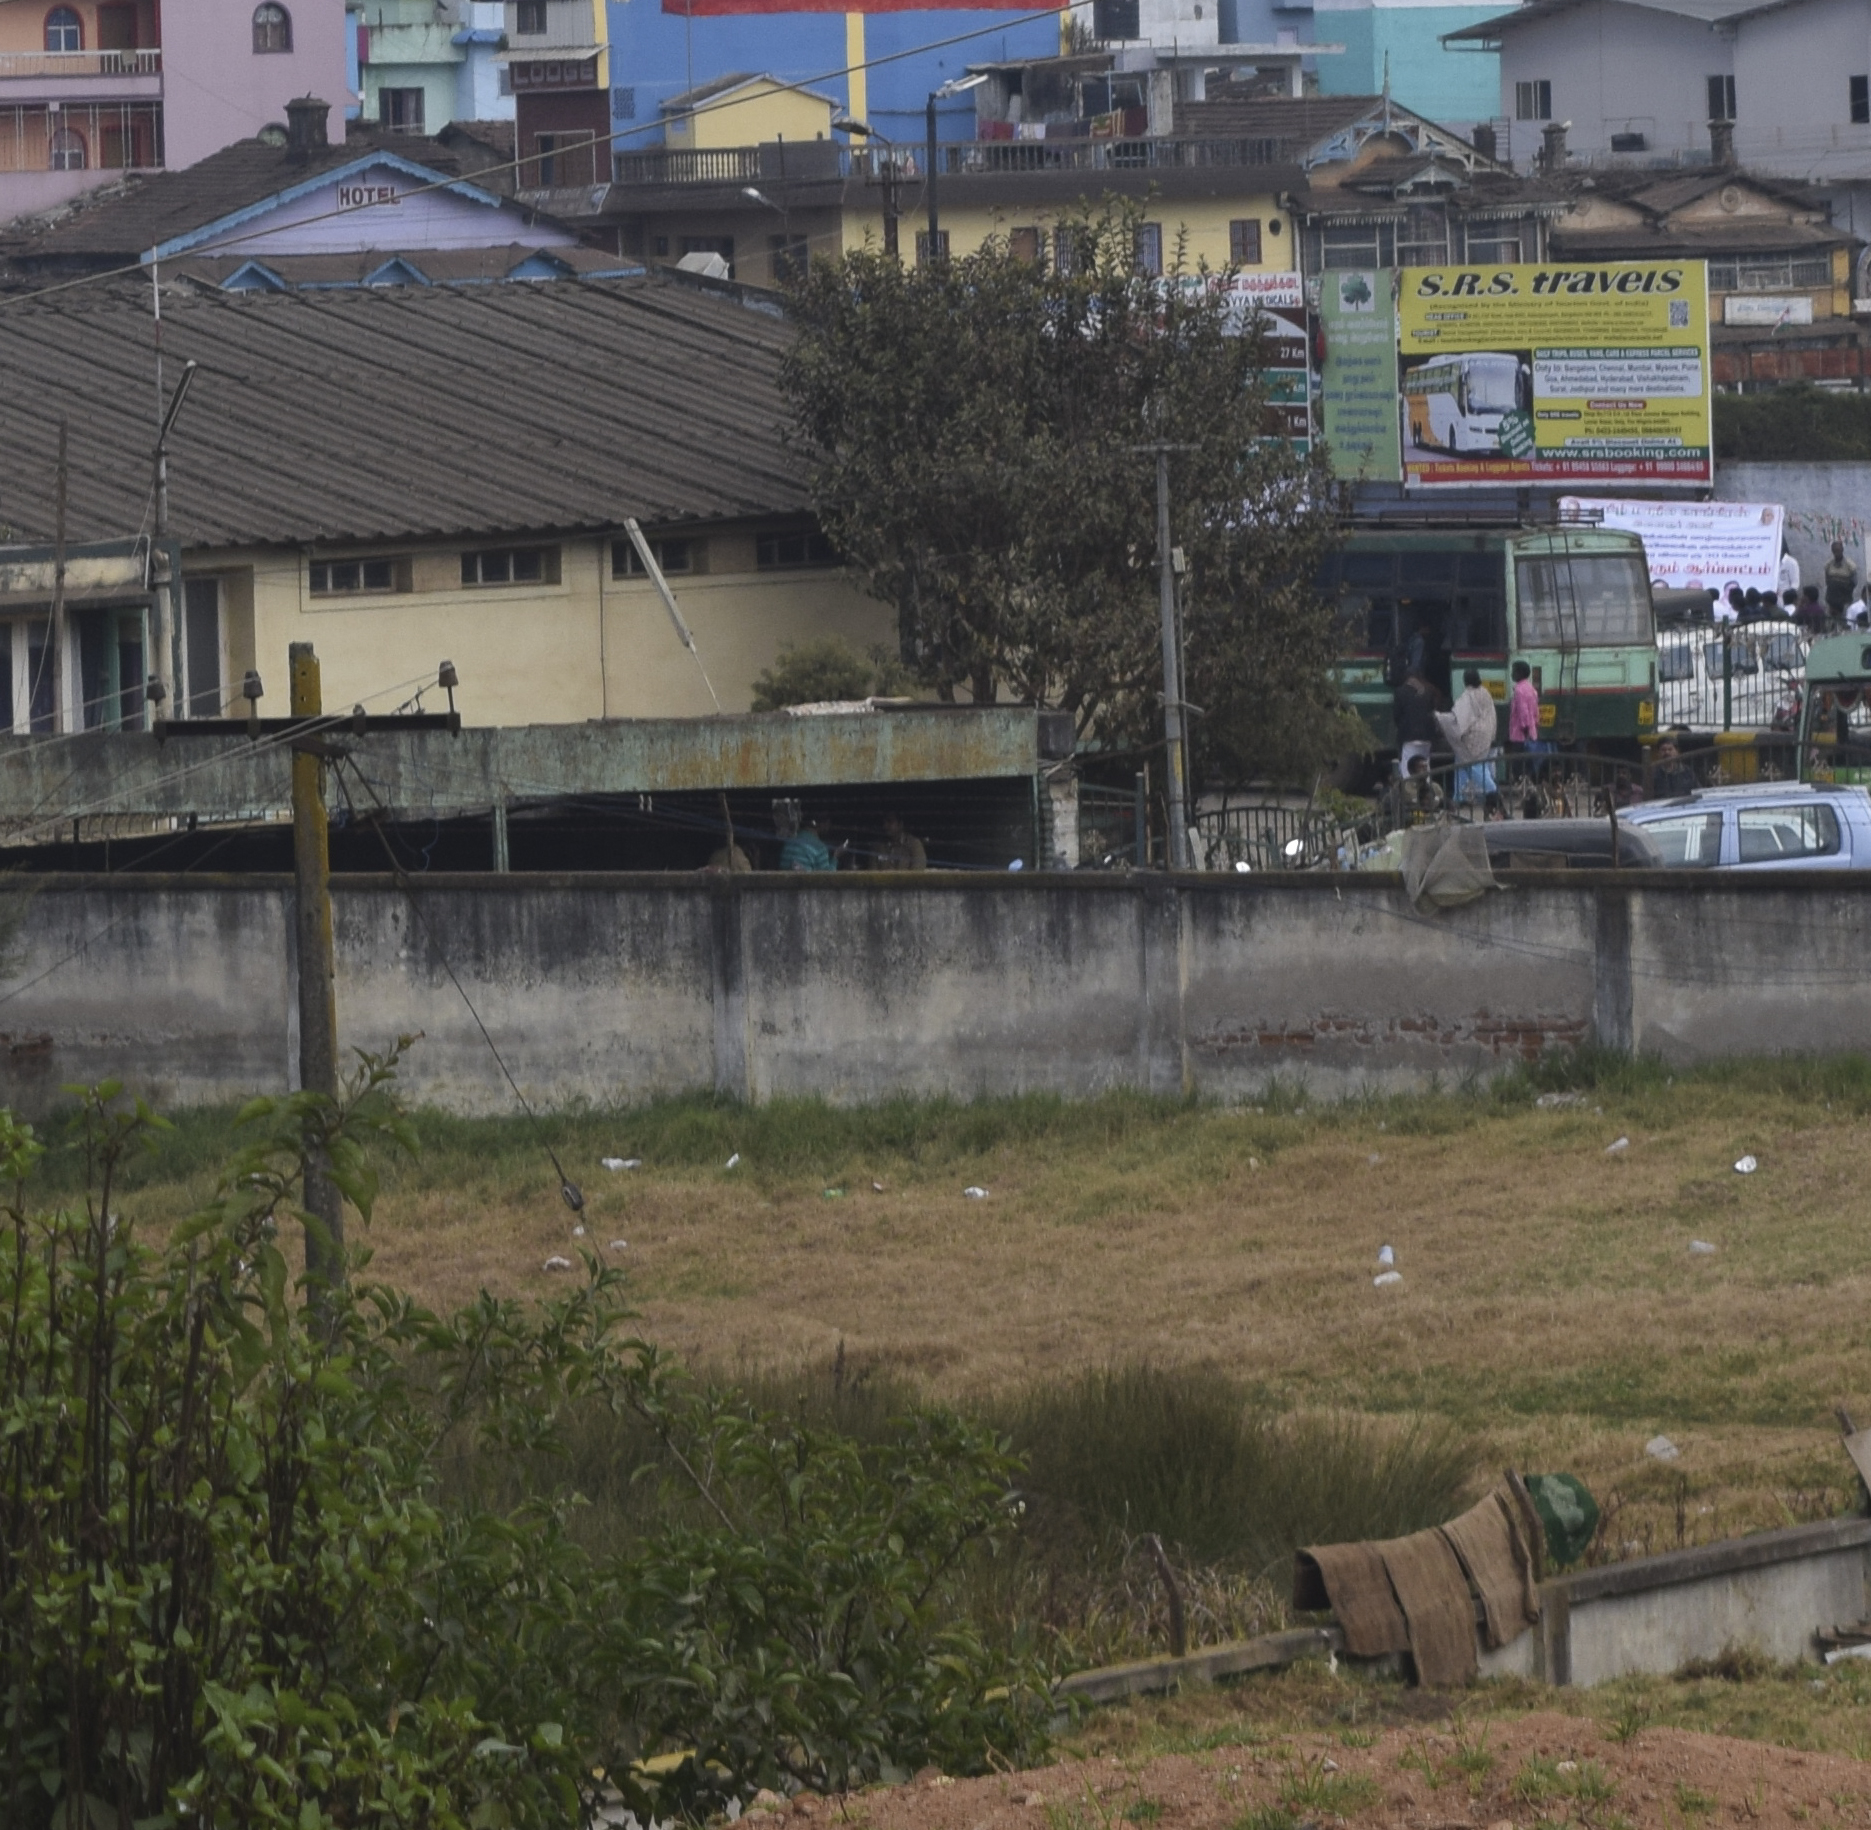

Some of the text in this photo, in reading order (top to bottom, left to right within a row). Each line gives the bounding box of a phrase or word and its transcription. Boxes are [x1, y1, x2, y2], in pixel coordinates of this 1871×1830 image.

[514, 62, 596, 84] LODGE
[339, 186, 401, 206] HOTEL
[1417, 269, 1683, 297] S.R.S. travels
[1281, 348, 1305, 358] 27 Km
[1294, 417, 1307, 427] Km
[1542, 448, 1701, 459] www.srsbooking.com
